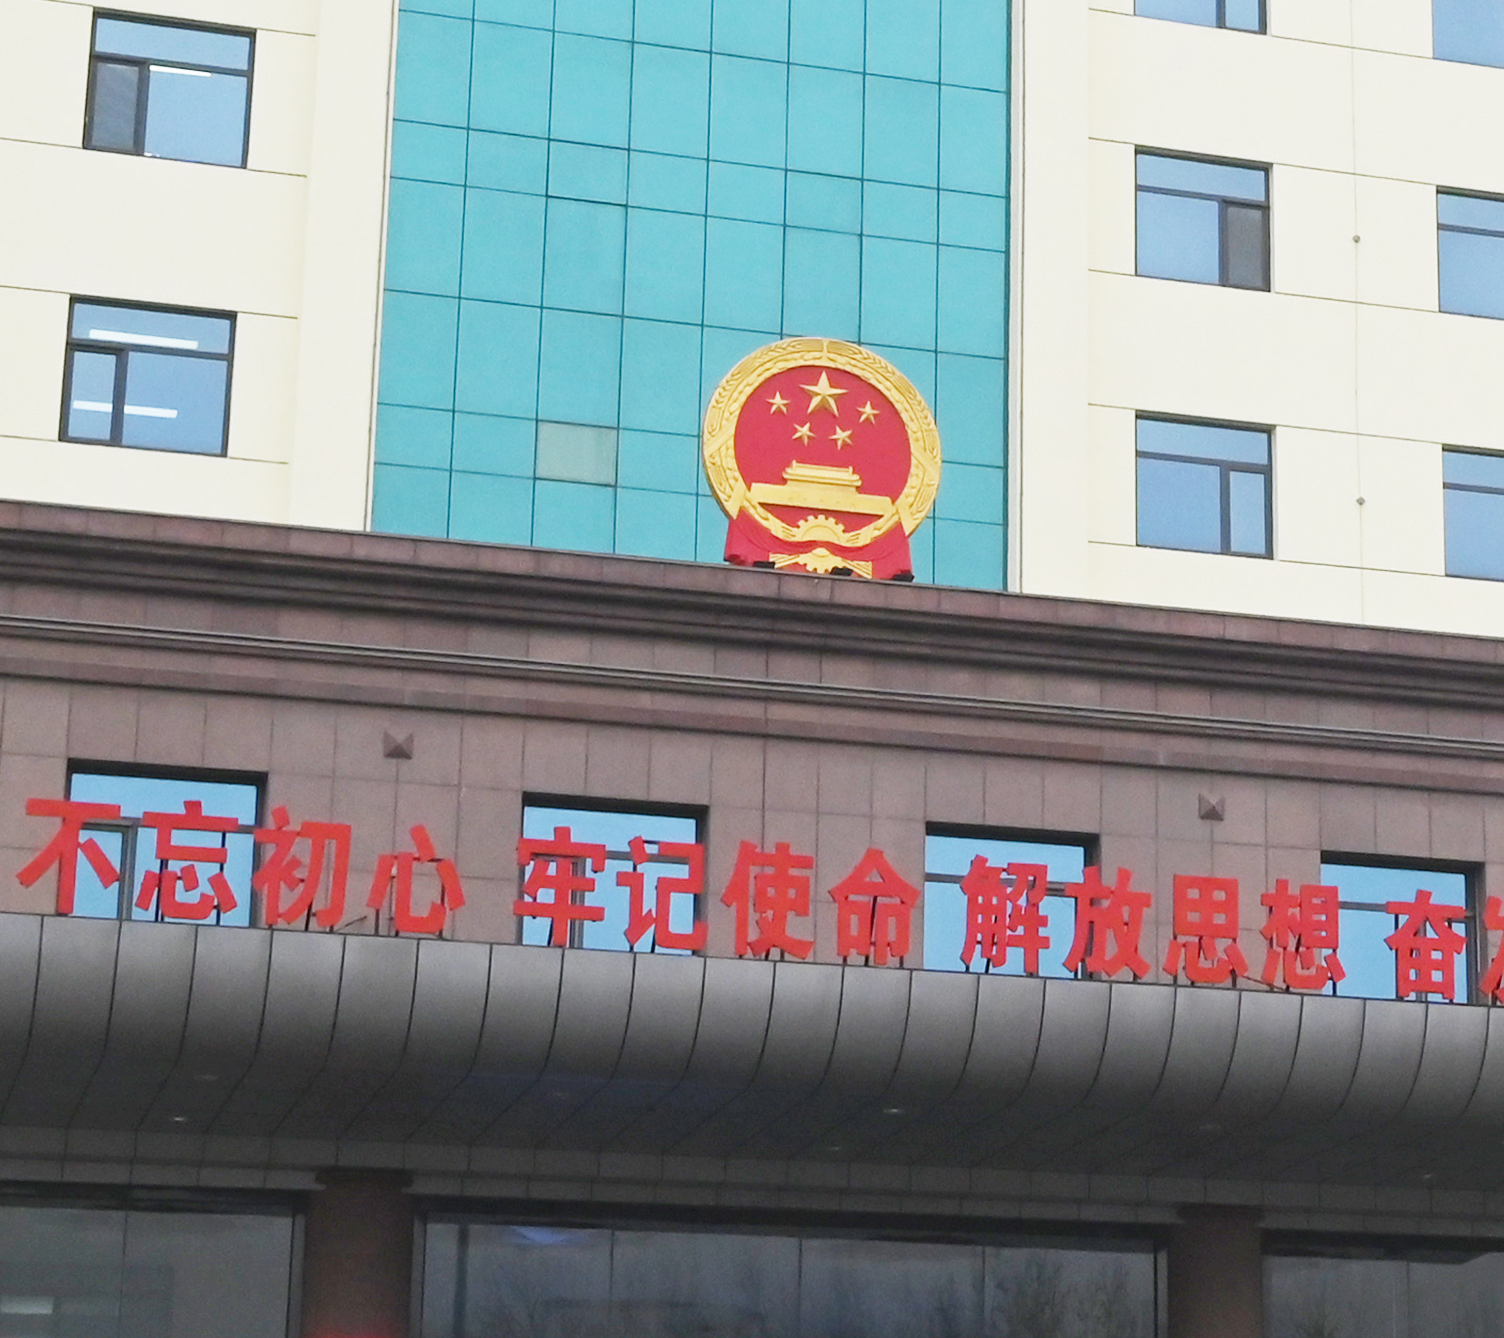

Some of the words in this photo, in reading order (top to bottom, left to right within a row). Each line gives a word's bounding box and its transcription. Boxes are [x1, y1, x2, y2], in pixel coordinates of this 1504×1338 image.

[16, 797, 467, 934] 不忘初心
[512, 826, 922, 966] 牢记使命
[961, 855, 1347, 991] 解放思想
